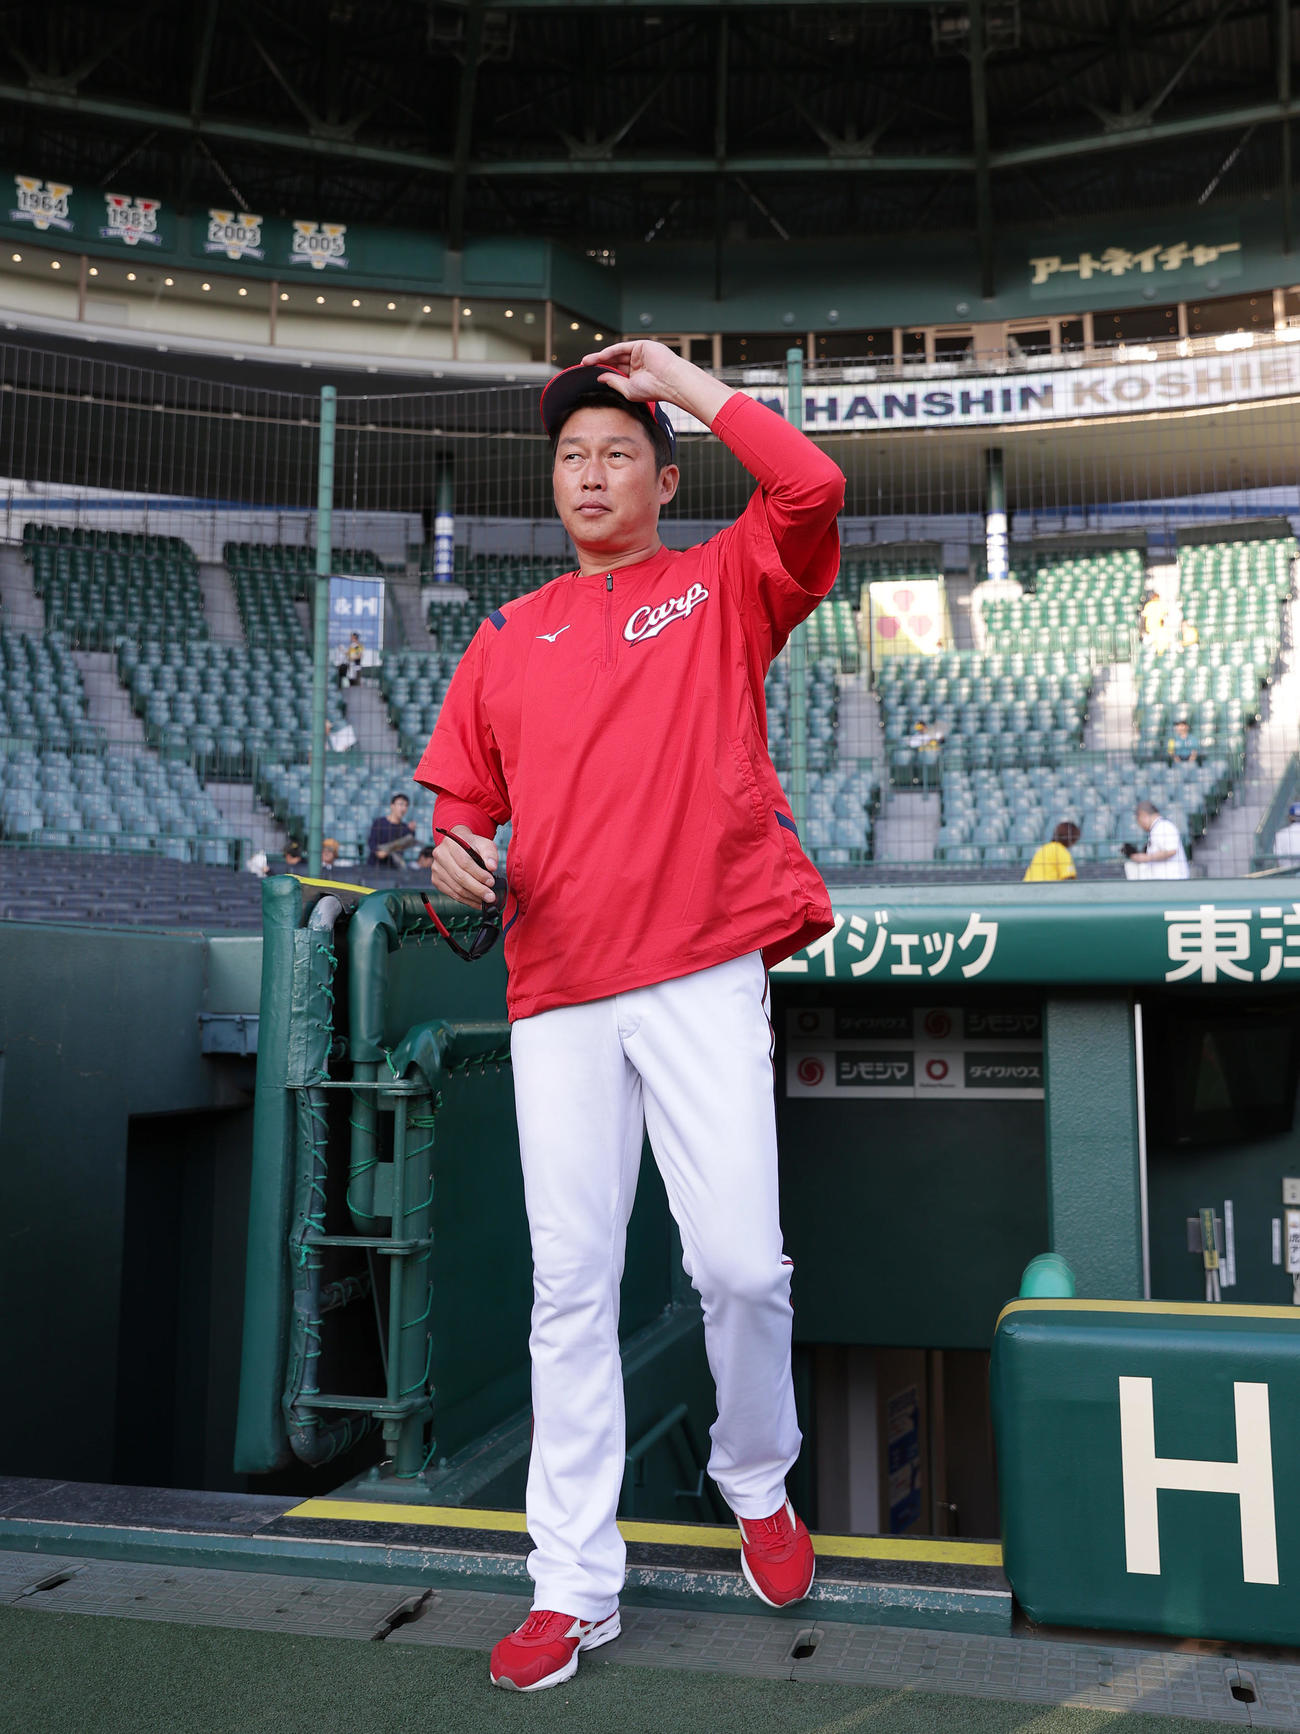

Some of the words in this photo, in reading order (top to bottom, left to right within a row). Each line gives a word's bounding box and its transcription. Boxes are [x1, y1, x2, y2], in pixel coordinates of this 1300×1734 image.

[21, 191, 64, 214] 1964
[111, 207, 154, 229] 1985
[213, 223, 258, 244] 2003
[297, 235, 342, 252] 2005
[1029, 241, 1242, 285] アートネイチャー
[804, 382, 1053, 422] HANSHIN
[1072, 357, 1295, 407] KOSHIE
[622, 582, 709, 648] Carp
[768, 910, 999, 979] イジェック
[968, 1014, 1039, 1033] シモジマ
[840, 1061, 909, 1080] シモジマ
[969, 1066, 1041, 1078] ダイワハウス
[1119, 1375, 1280, 1586] H
